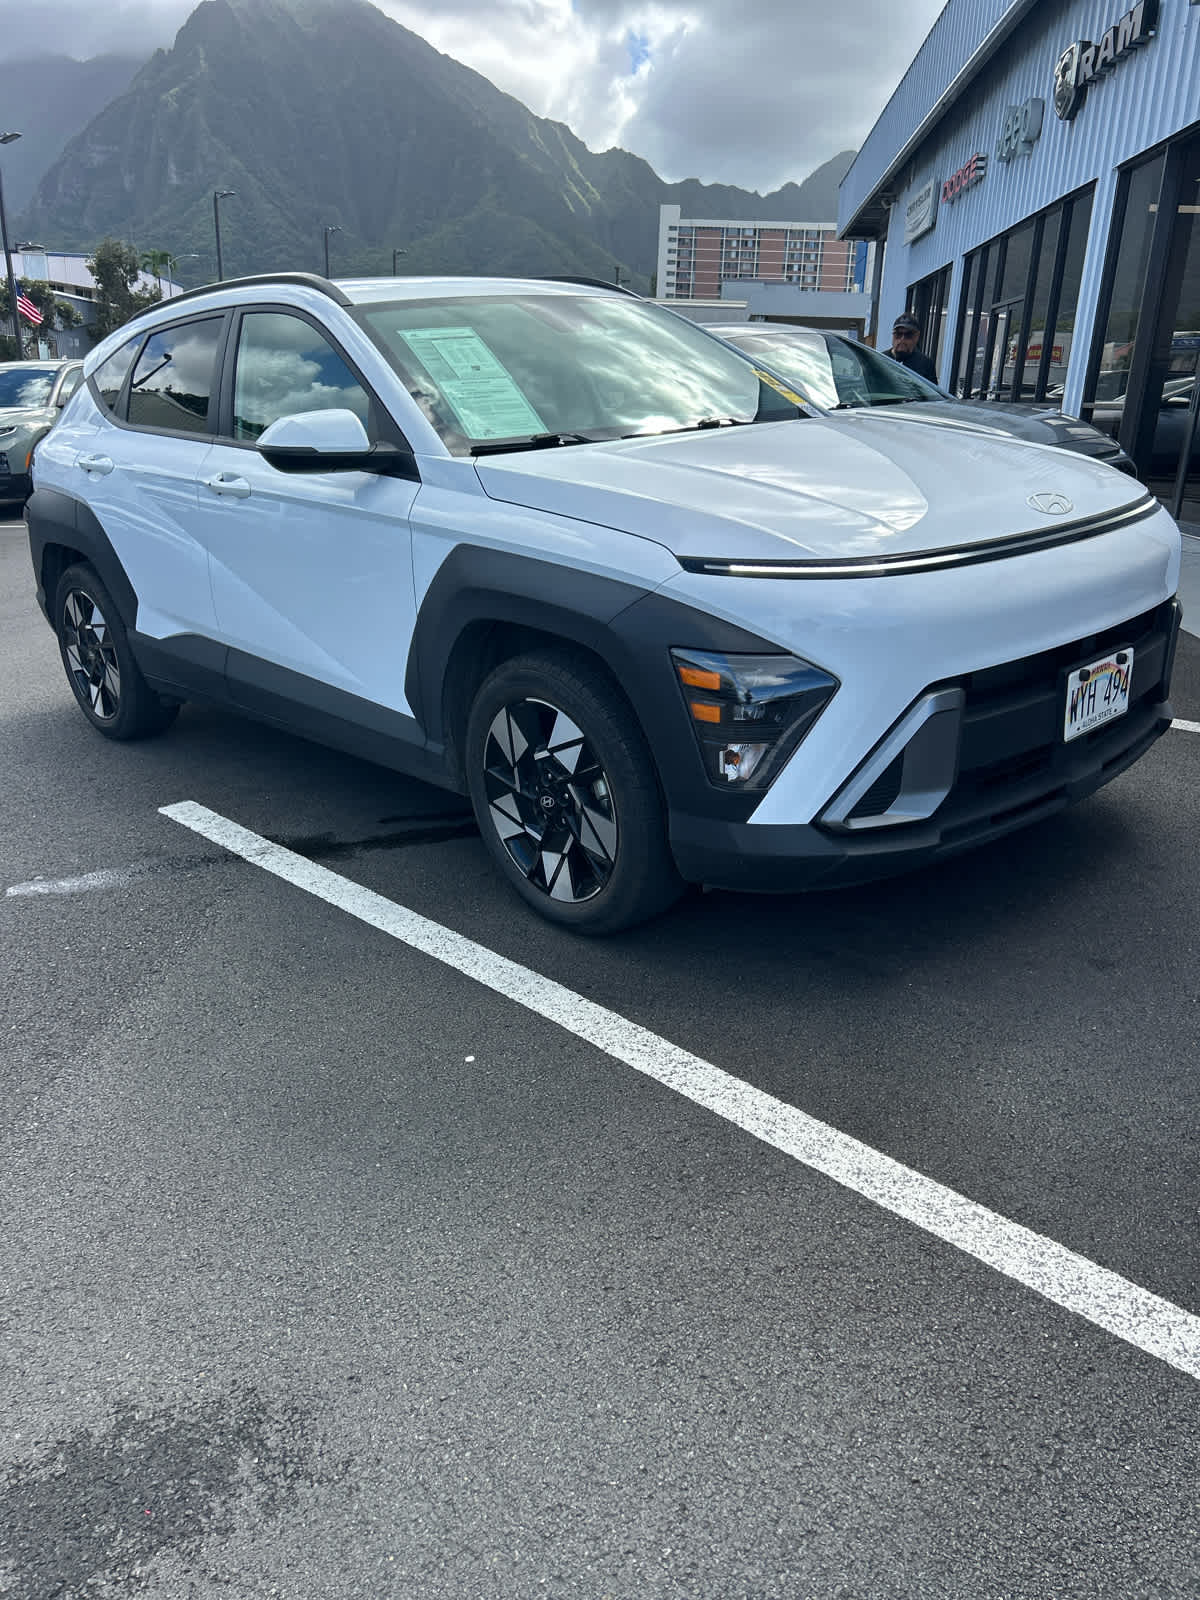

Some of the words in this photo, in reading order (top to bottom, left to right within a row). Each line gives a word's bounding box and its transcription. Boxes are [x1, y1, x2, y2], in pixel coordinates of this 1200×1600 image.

[1078, 0, 1146, 87] RAM
[941, 152, 979, 203] DODGE
[1104, 664, 1130, 705] 494
